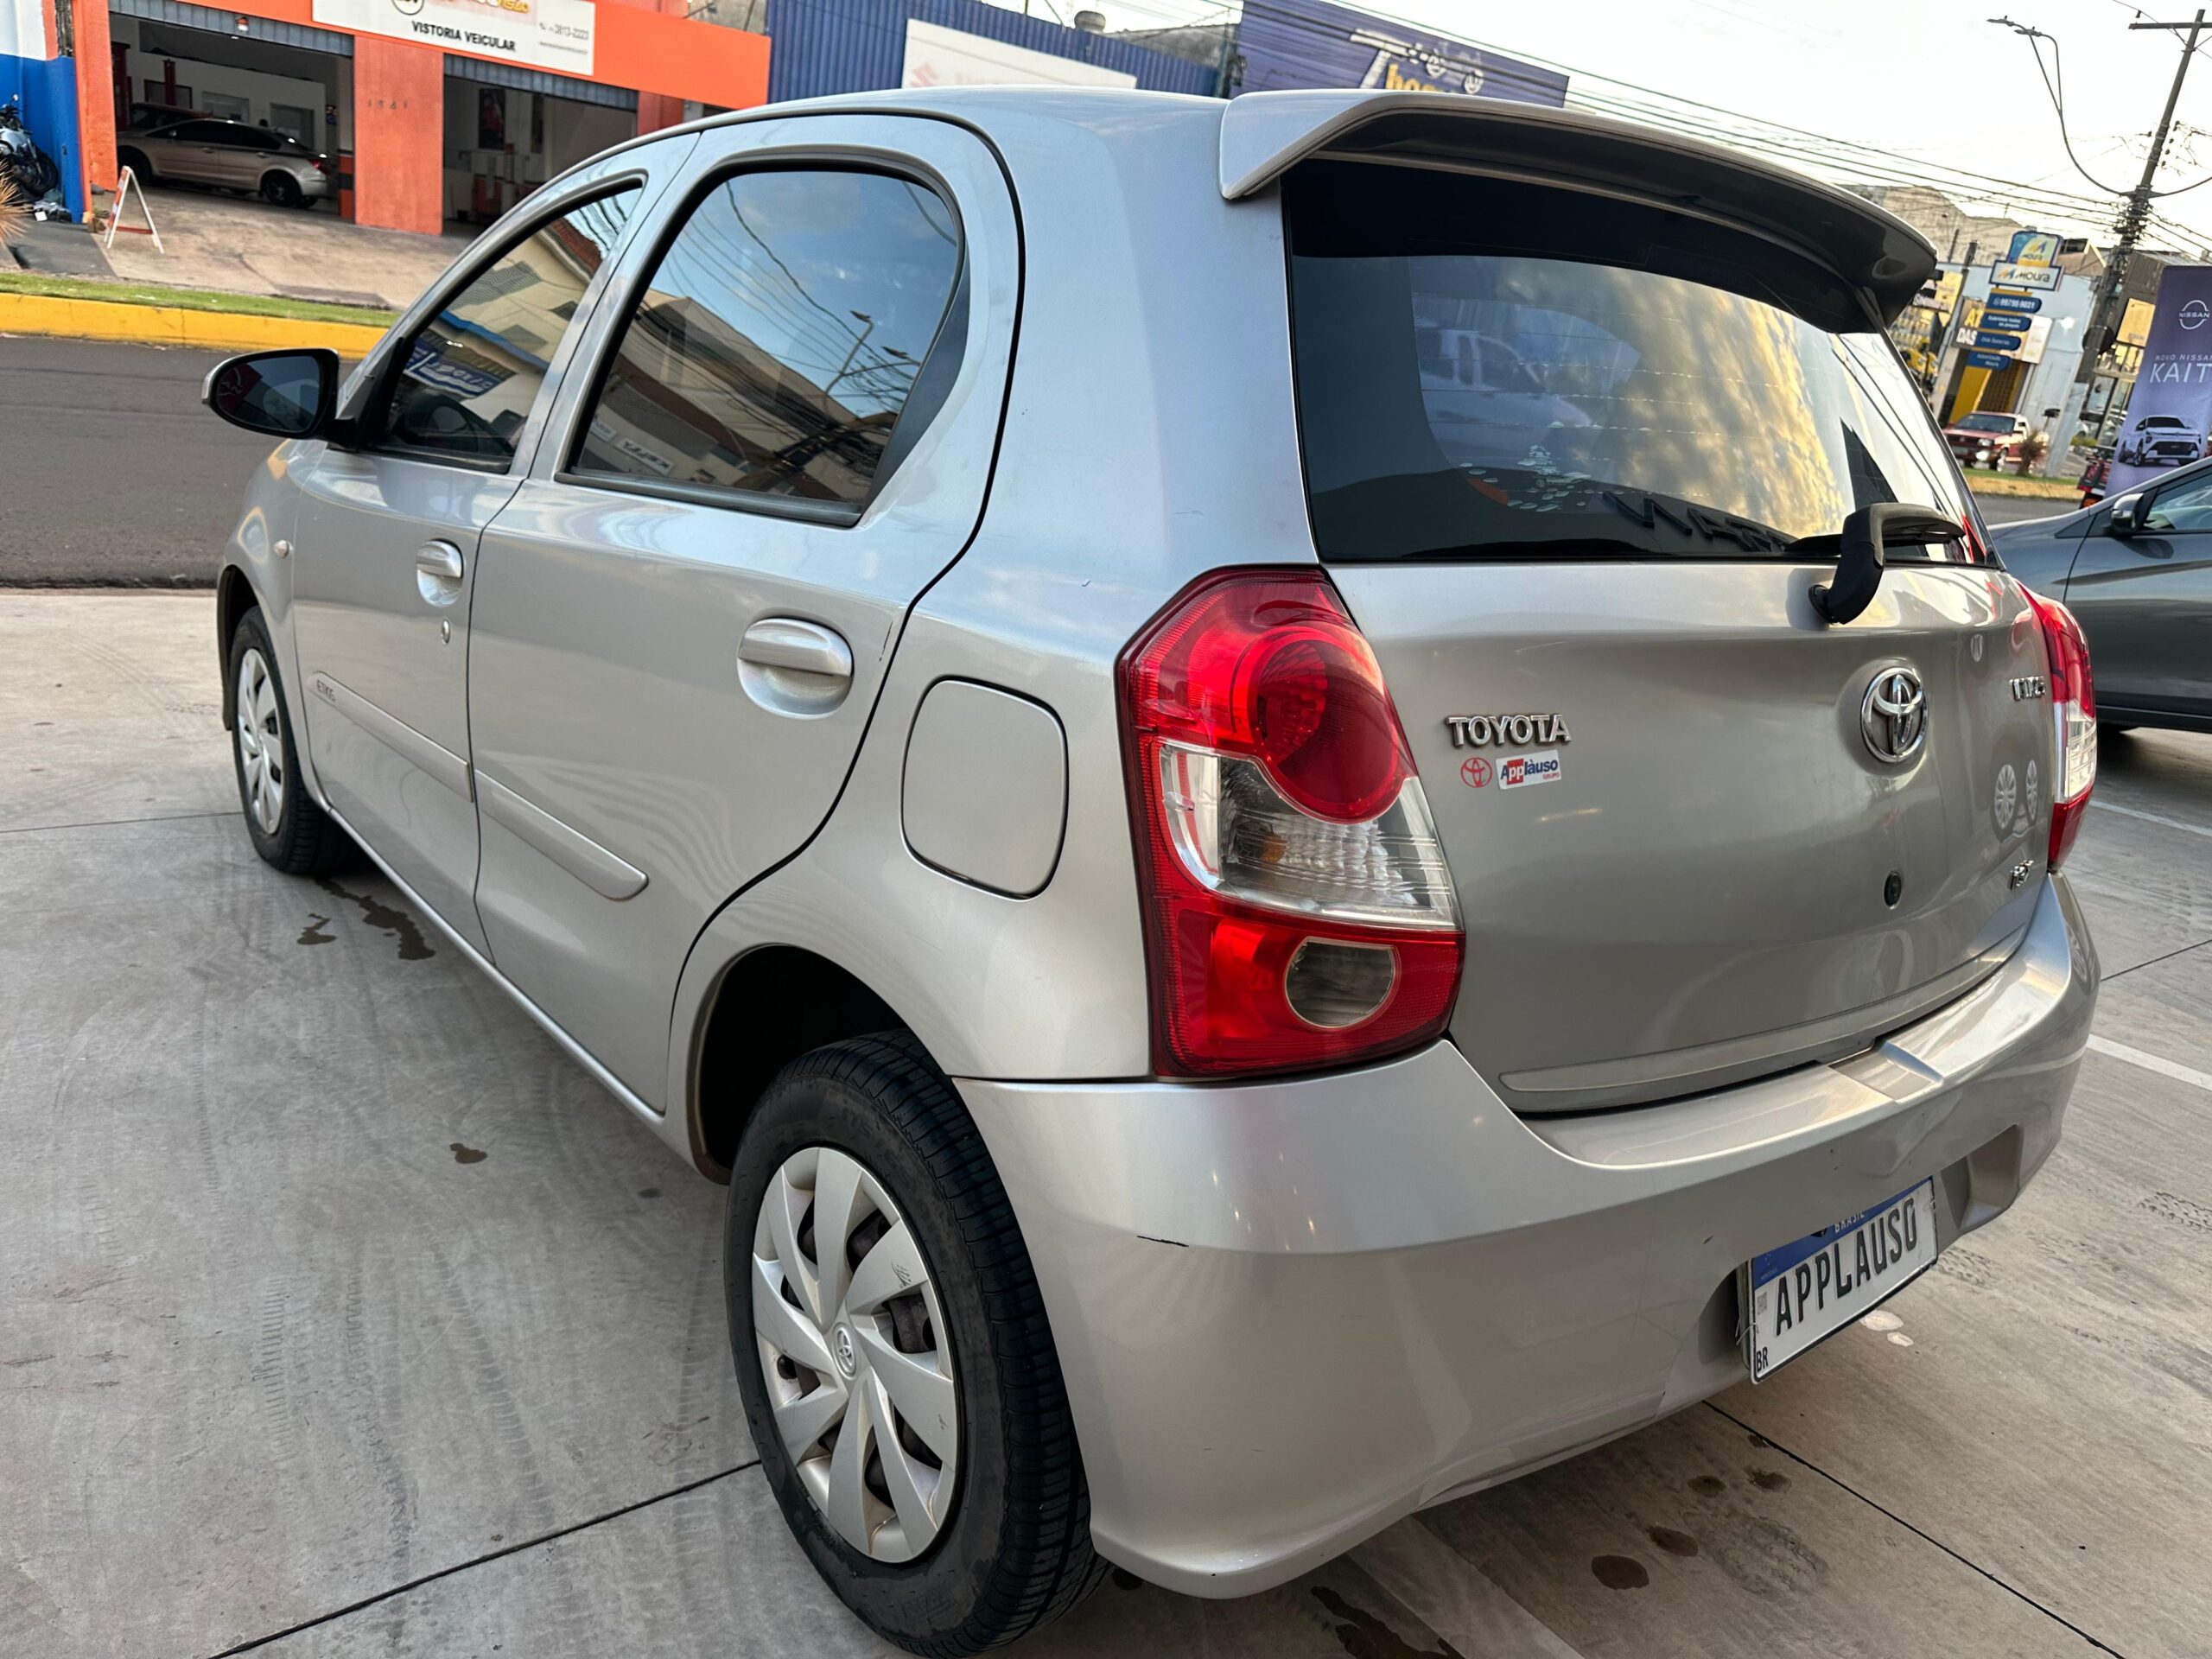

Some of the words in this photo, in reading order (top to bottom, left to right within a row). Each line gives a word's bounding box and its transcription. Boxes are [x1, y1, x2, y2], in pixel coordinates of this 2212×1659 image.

[411, 20, 462, 41] VISTORIA
[464, 30, 516, 51] VEICULAR
[2150, 362, 2212, 383] KAIT
[1445, 714, 1572, 747] TOYOTA
[1541, 772, 1560, 780] GRUPO
[1776, 1196, 1917, 1338] APPLAUSO
[1756, 1346, 1769, 1373] BR
